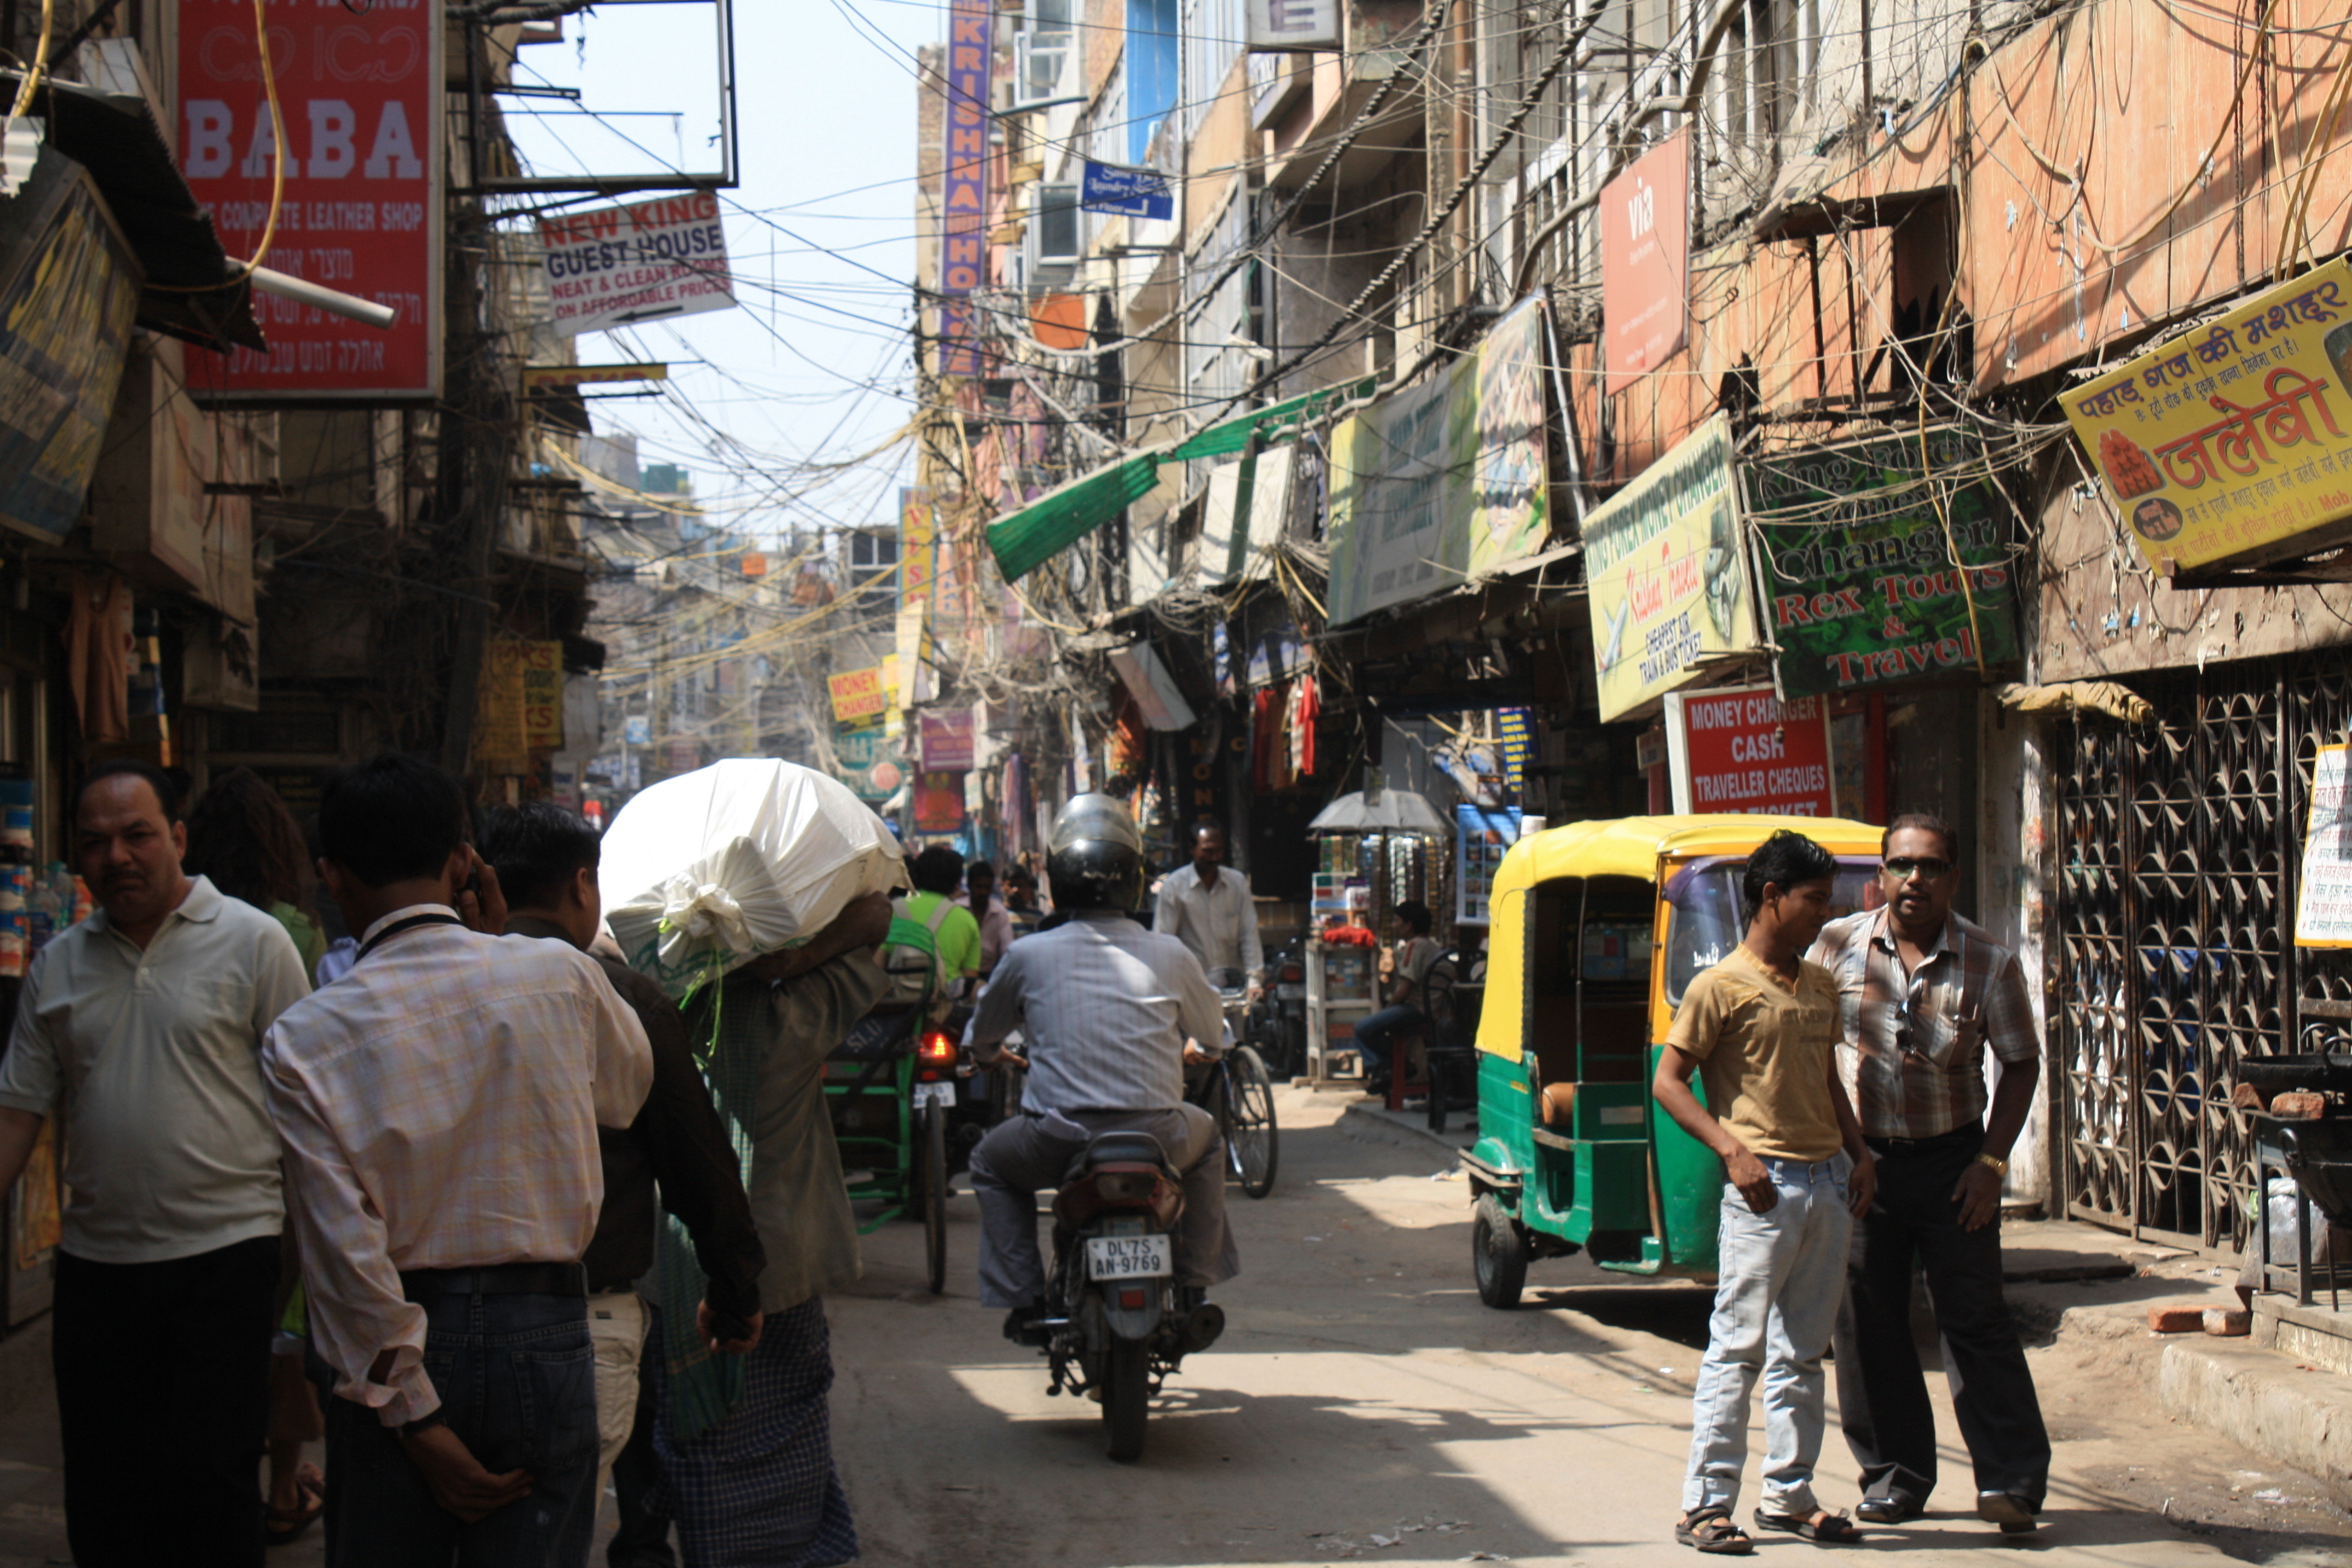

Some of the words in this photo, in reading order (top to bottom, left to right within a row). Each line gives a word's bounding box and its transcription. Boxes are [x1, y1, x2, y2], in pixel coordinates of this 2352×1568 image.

[949, 19, 985, 209] KRISHNA
[185, 99, 422, 179] BABA
[221, 201, 301, 230] COMPLETE
[307, 201, 375, 231] LEATHER
[382, 201, 423, 231] SHOP
[540, 210, 619, 247] NEW
[633, 193, 717, 231] KING
[1628, 177, 1653, 241] via
[547, 241, 628, 278] GUEST
[637, 224, 723, 265] HOUSE
[552, 278, 594, 301] NEAT
[599, 276, 610, 291] &
[615, 267, 666, 290] CLEAN
[670, 256, 727, 279] ROOMS
[555, 301, 575, 319] ON
[581, 284, 675, 318] AFFORDABLE
[679, 276, 732, 299] PRICES
[2077, 377, 2145, 419] पहाड़
[2143, 354, 2195, 388] गंज
[2195, 326, 2242, 364] की
[2241, 280, 2347, 345] मशहूर
[2270, 345, 2286, 360] पर
[2154, 367, 2349, 489] जलेबी
[1753, 459, 1855, 501] King
[1866, 436, 1987, 481] Forex
[1638, 471, 1674, 543] MONEY
[1674, 433, 1728, 518] CHANGER
[1810, 486, 1936, 535] Money
[1772, 518, 1996, 583] Changer
[1774, 587, 1865, 630] Rex
[1873, 565, 2007, 609] Tours
[1883, 615, 1909, 639] &
[1826, 627, 1976, 687] Travel
[831, 671, 878, 698] MONEY
[835, 693, 884, 719] CHANGER
[1691, 700, 1742, 731] MONEY
[1746, 696, 1817, 725] CHANGER
[1731, 733, 1785, 763] CASH
[1695, 769, 1766, 802] TRAVELLER
[1768, 764, 1826, 795] CHEQUES
[1096, 1253, 1160, 1276] AN-9769
